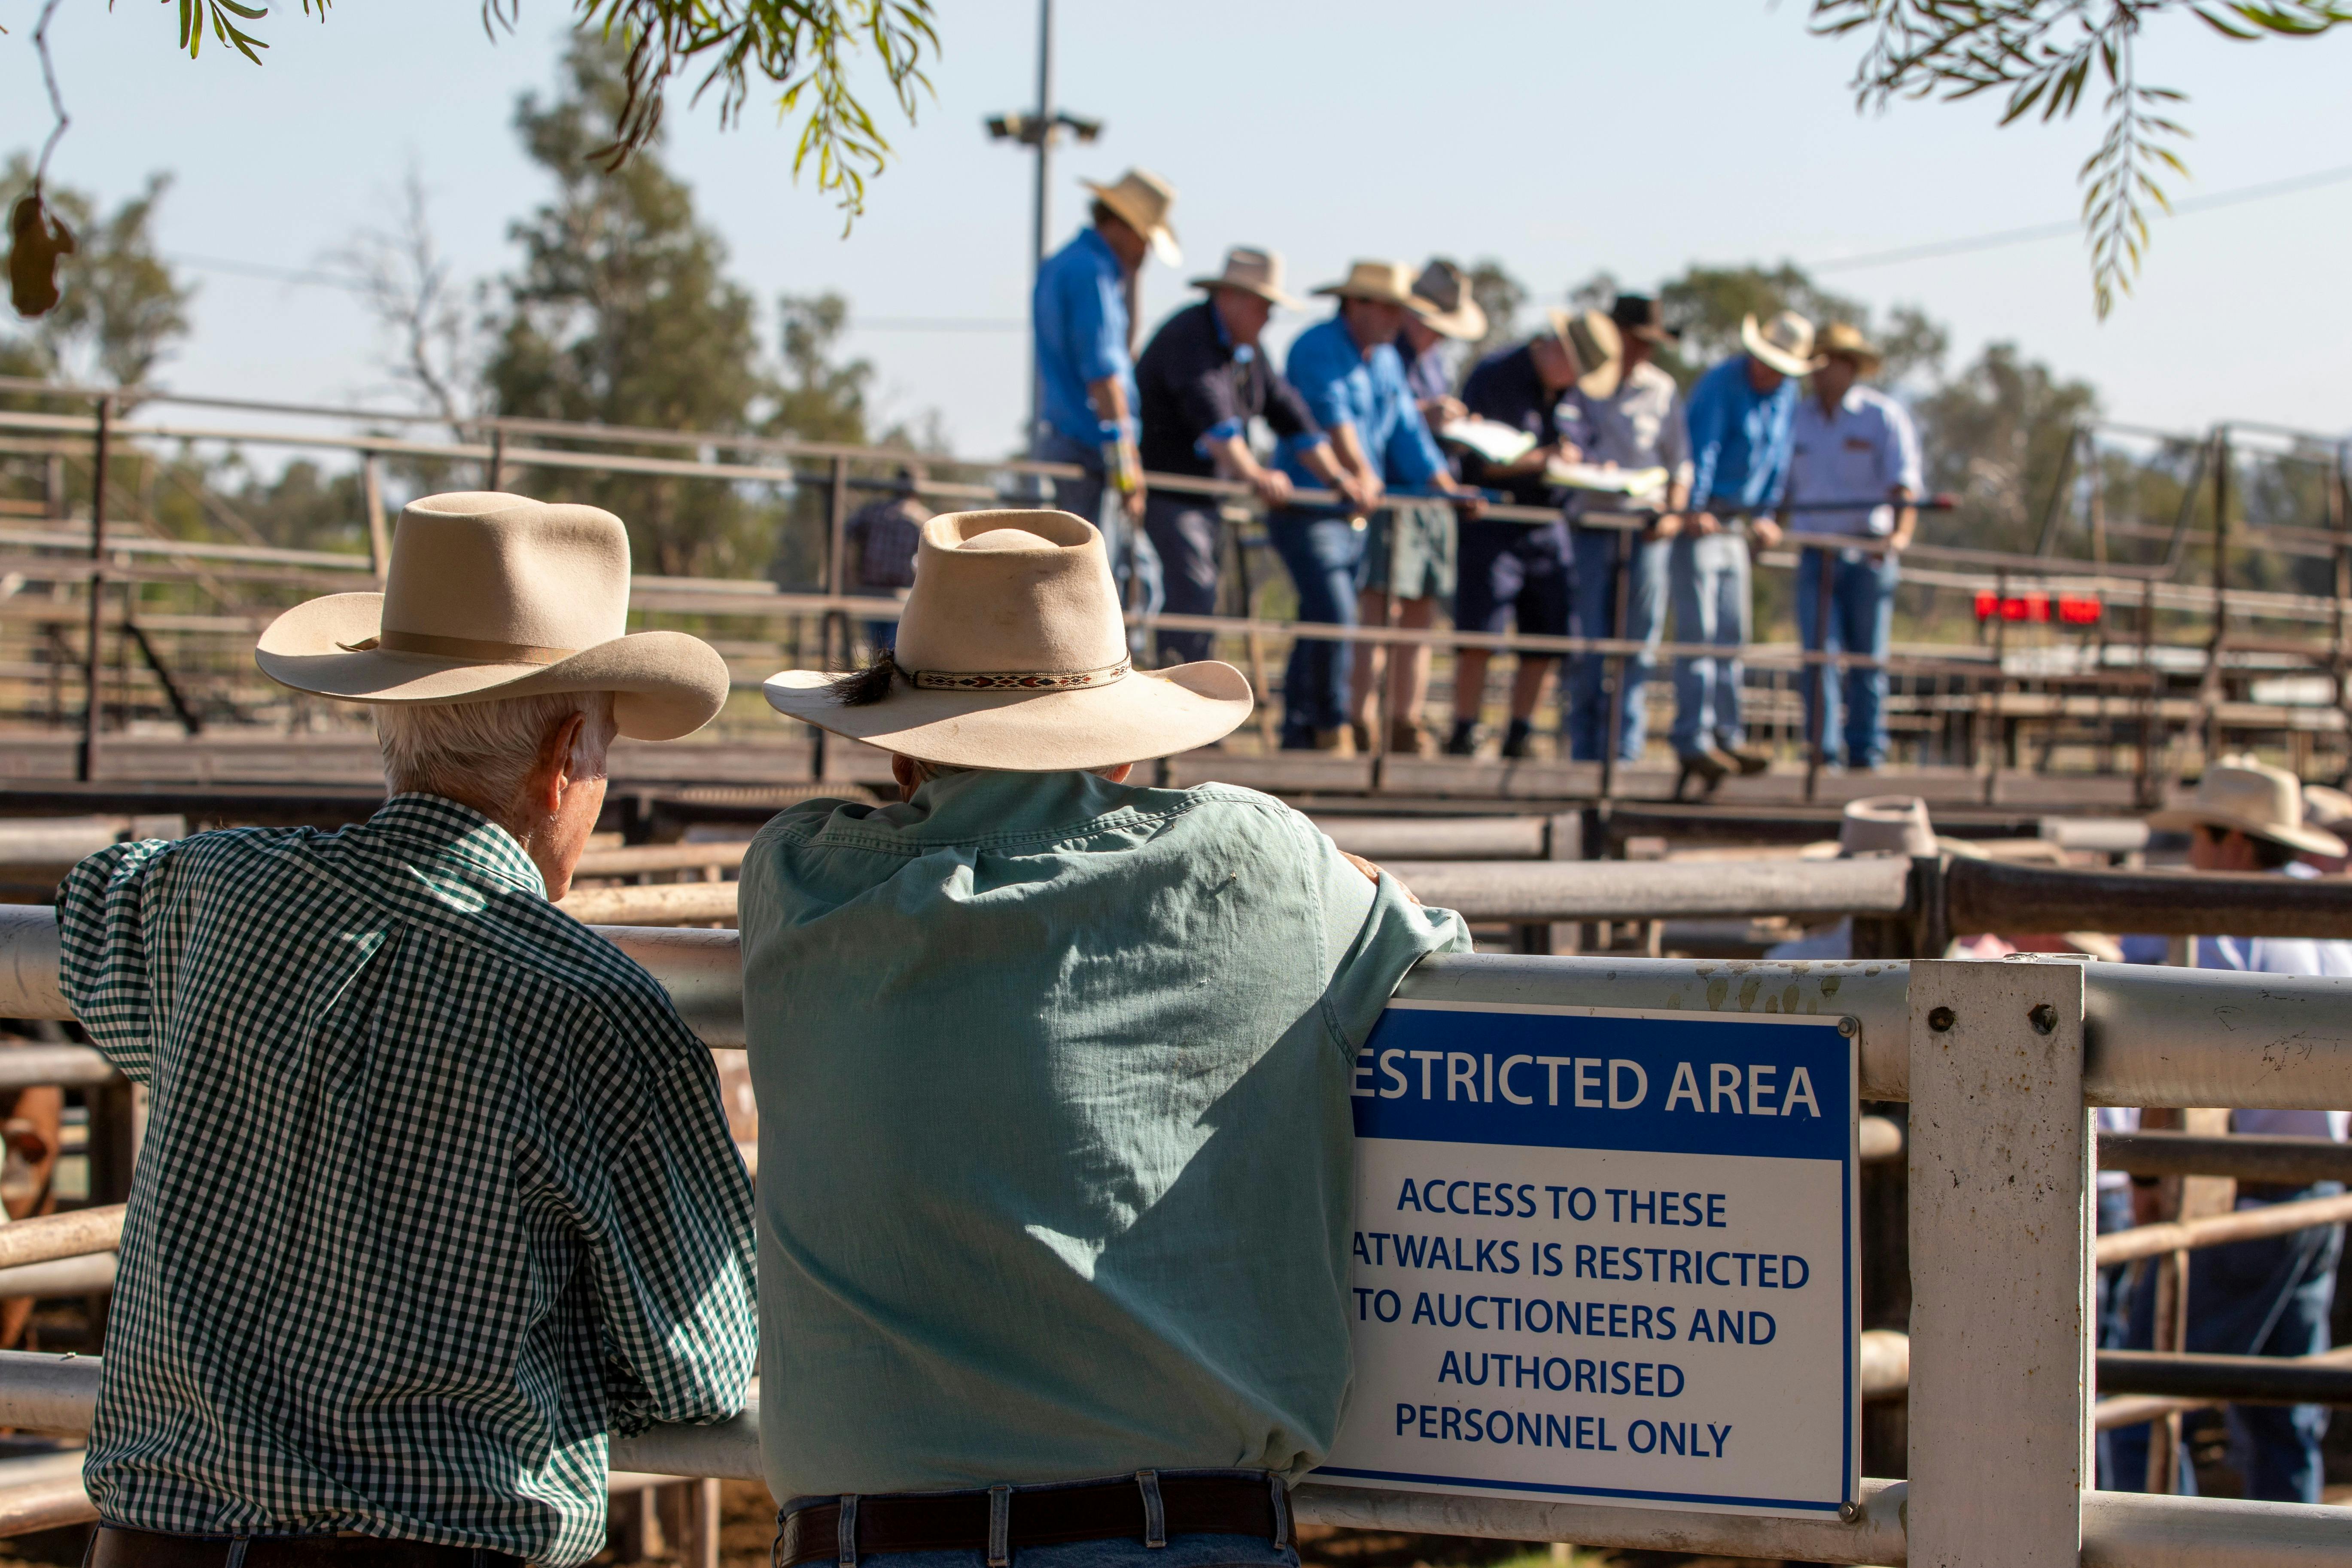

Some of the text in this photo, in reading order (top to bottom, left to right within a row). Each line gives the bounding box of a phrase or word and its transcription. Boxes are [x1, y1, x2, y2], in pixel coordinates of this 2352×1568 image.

[1350, 1047, 1821, 1117] ESTRICTED AREA
[1397, 1178, 1727, 1227] ACCESS TO THESE
[1353, 1231, 1810, 1289] ATWALKS IS RESTRICTED
[1353, 1288, 1777, 1345] TO AUCTIONEERS AND
[1438, 1351, 1685, 1397] AUTHORISED
[1397, 1404, 1732, 1458] PERSONNEL ONLY
